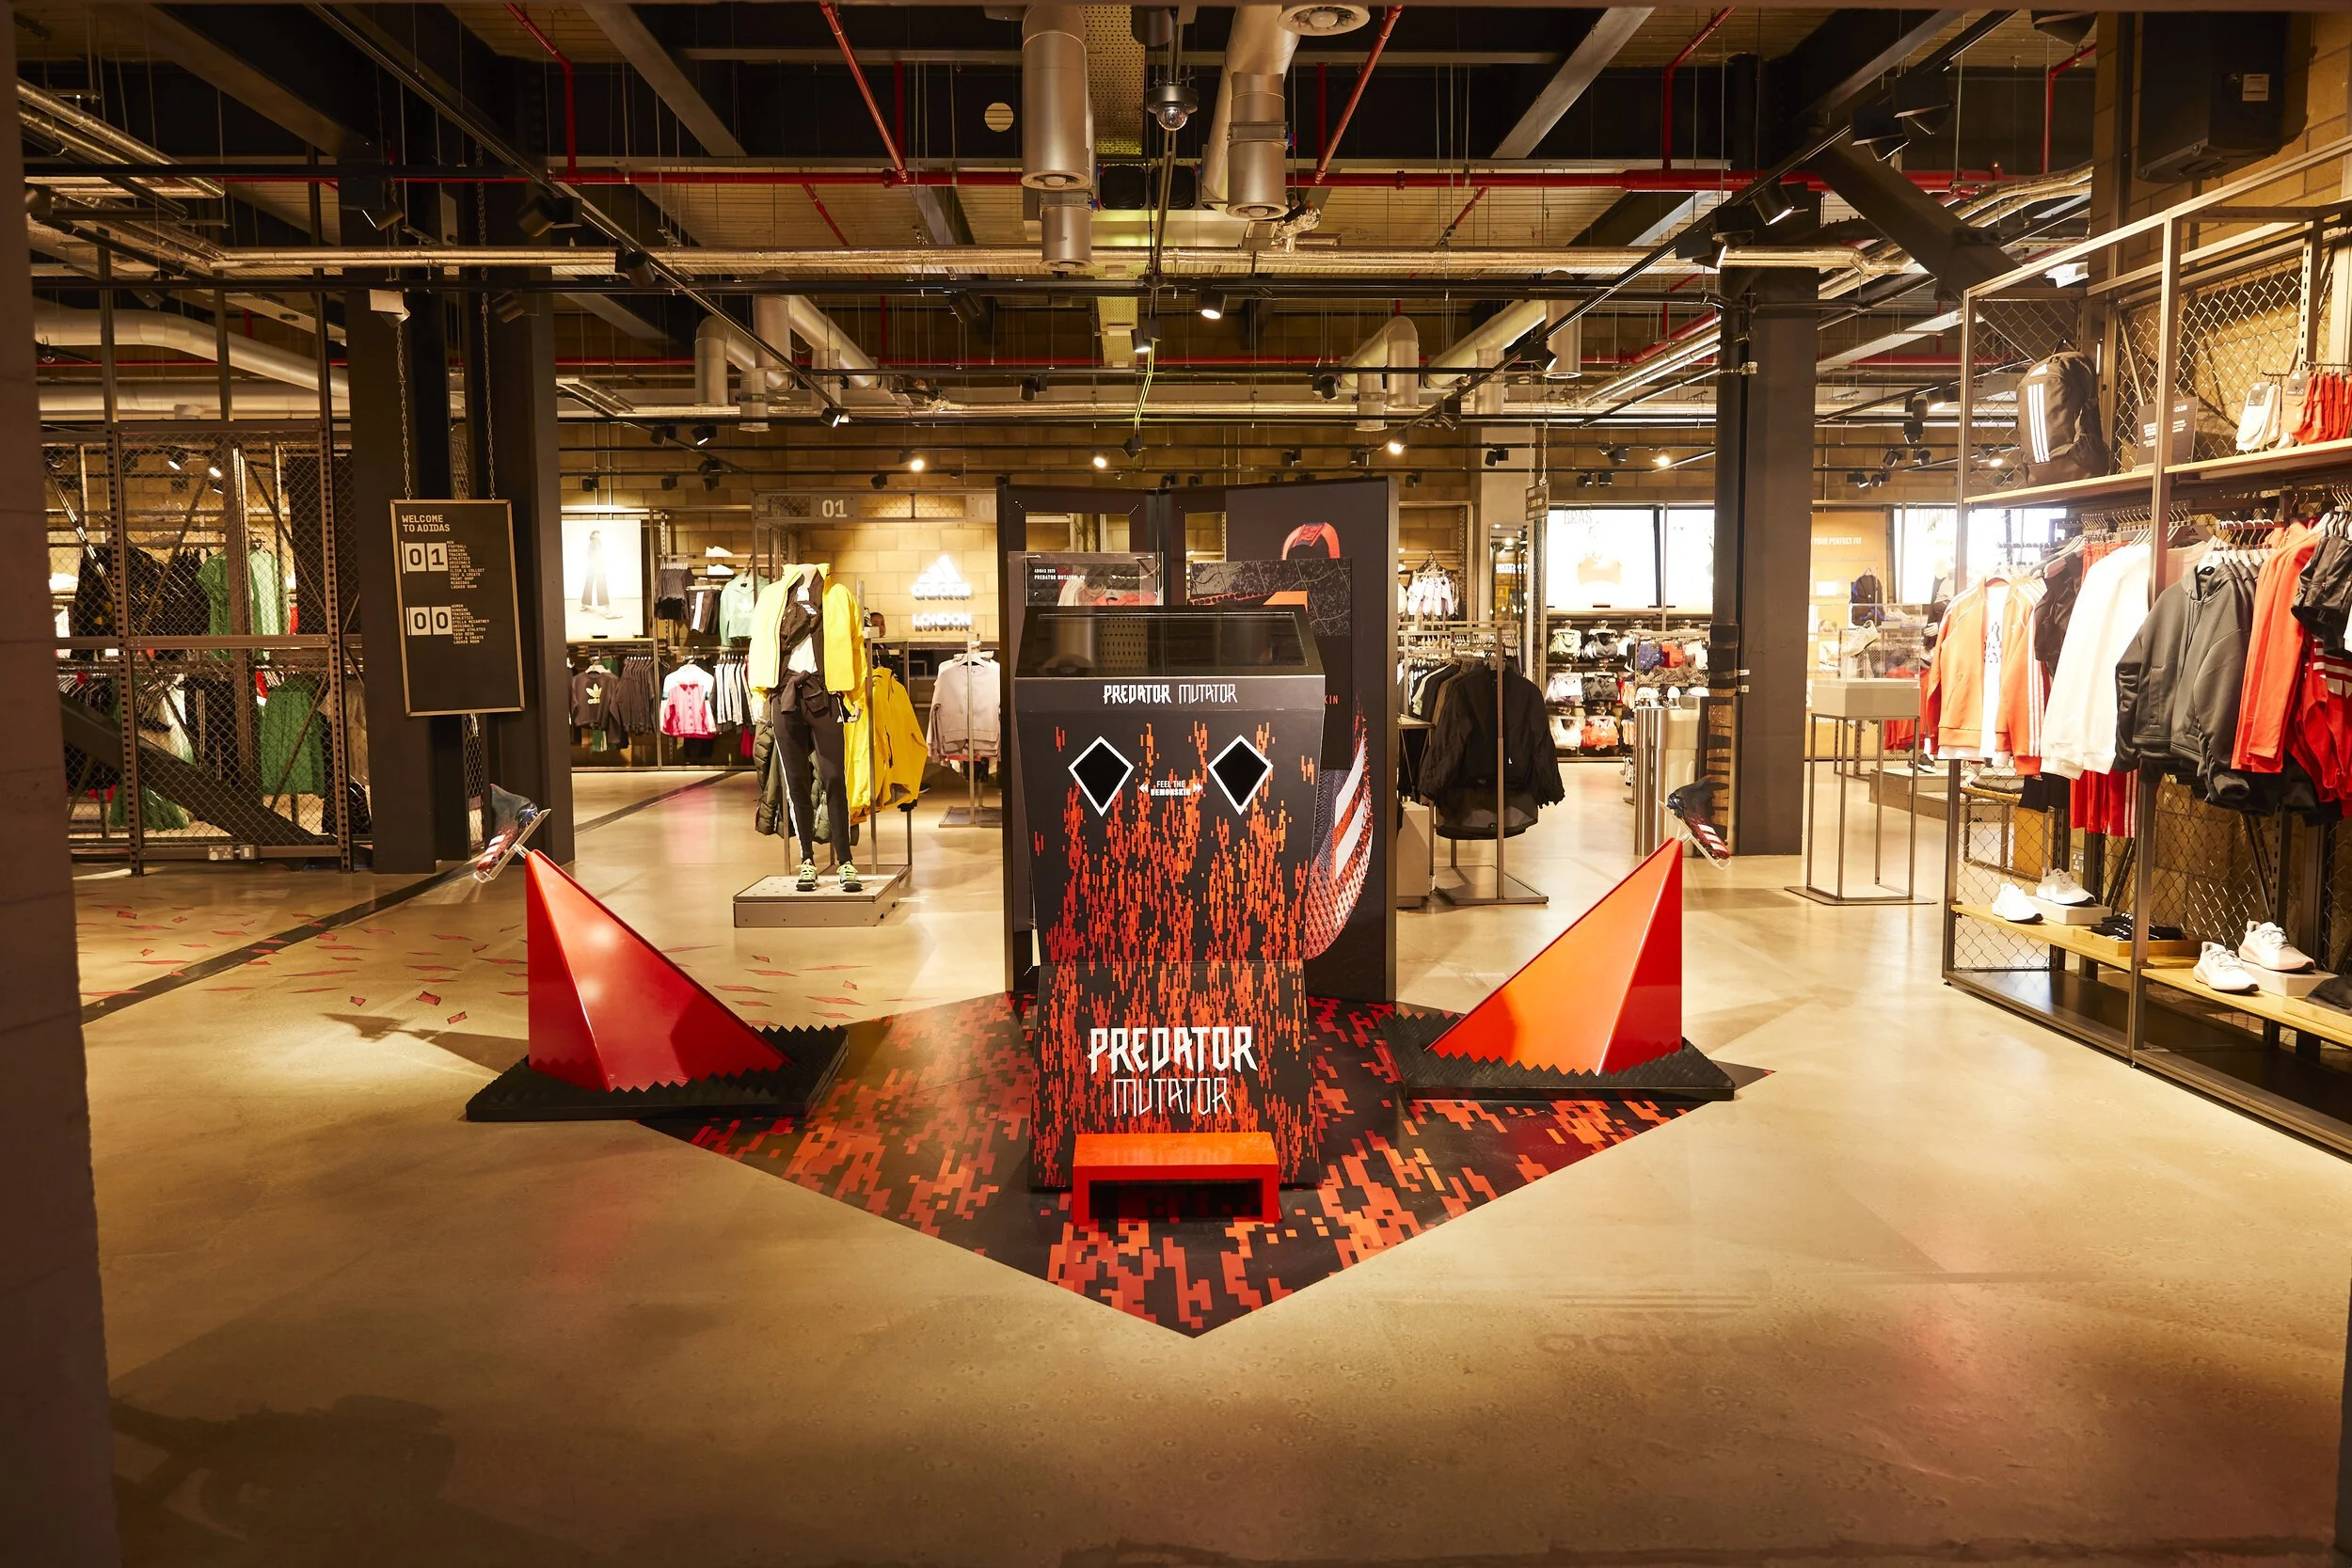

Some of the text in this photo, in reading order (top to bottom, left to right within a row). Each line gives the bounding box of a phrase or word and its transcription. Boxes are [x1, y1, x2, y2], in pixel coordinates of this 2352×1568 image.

[822, 499, 847, 517] 01
[402, 515, 443, 523] WELCOME
[1564, 510, 1593, 525] BRAS
[403, 524, 451, 532] TO ADIDAS
[409, 548, 444, 566] 01
[414, 611, 448, 629] 00
[912, 613, 972, 632] LONDON
[1103, 684, 1238, 705] PREDATOR MUTATOR
[1324, 695, 1338, 704] KIN
[1150, 788, 1191, 797] DEMONSKIN
[1156, 780, 1185, 788] FEEL THE
[1087, 1026, 1258, 1075] PREDATOR
[1114, 1077, 1232, 1117] MUTATOR
